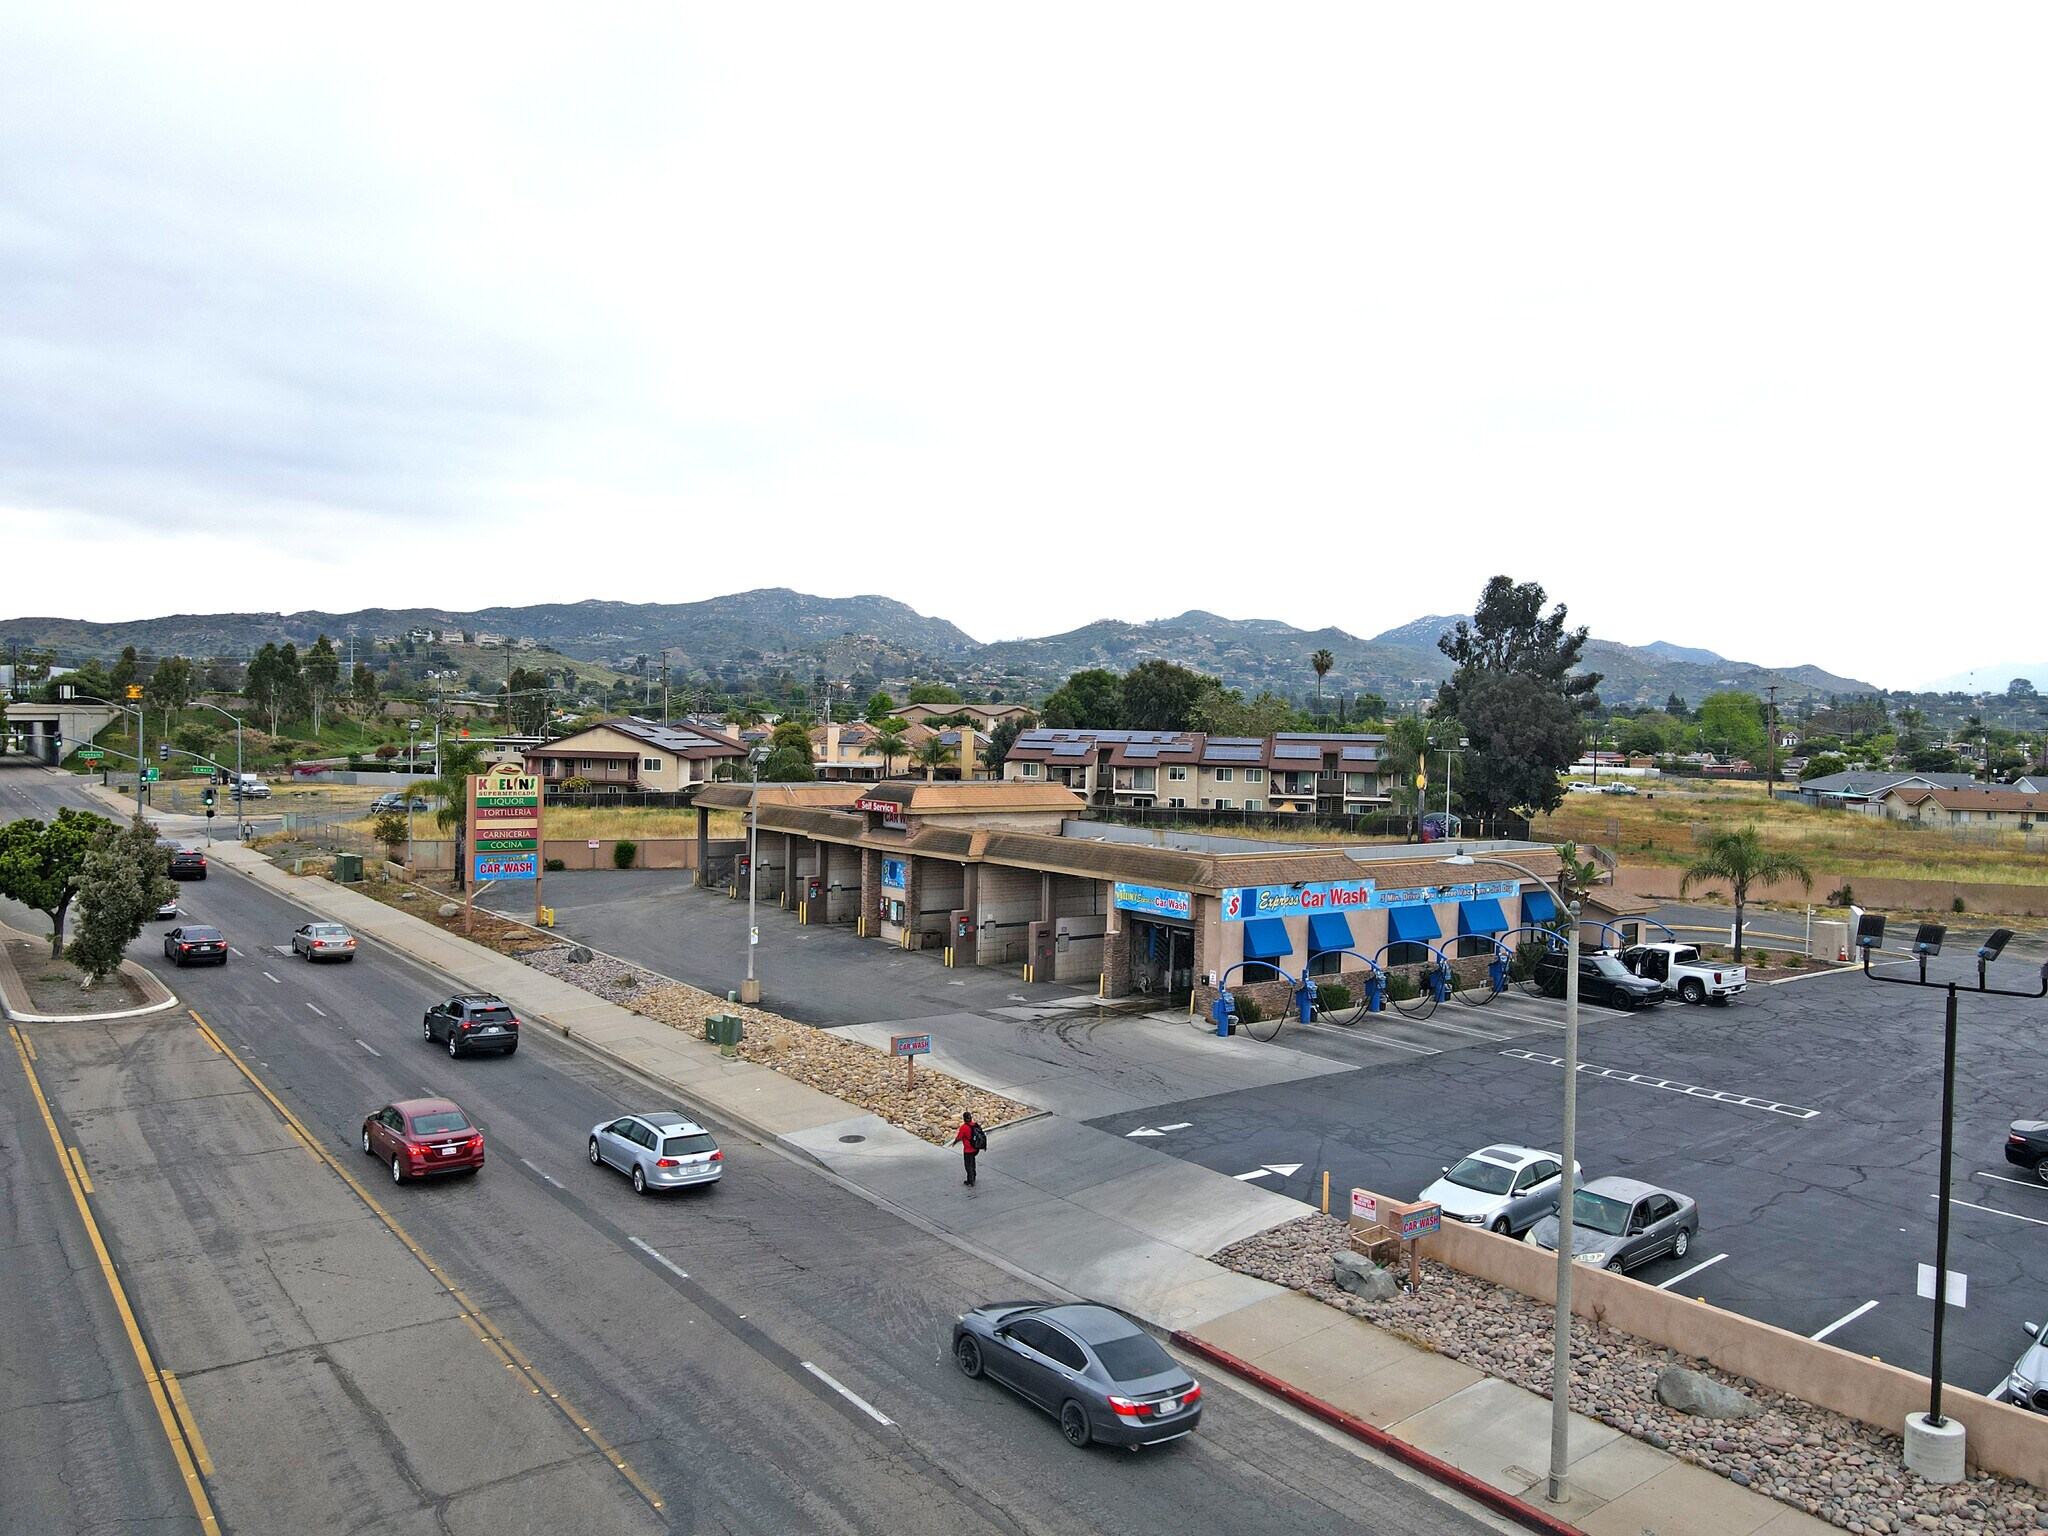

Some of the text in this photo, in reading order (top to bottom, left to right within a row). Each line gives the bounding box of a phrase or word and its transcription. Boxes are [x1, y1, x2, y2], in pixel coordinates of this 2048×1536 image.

[489, 798, 525, 806] LIQUOR
[861, 801, 894, 813] Self Service
[483, 808, 532, 817] TORTILLERIA
[884, 813, 899, 823] CAR
[483, 831, 531, 839] CARNICERIA
[490, 841, 523, 849] COCINA
[480, 862, 532, 874] CAR WASH
[1403, 891, 1421, 900] Drive
[1490, 885, 1501, 894] Jet
[1502, 883, 1514, 894] Dry
[1155, 897, 1167, 908] Car
[1168, 899, 1188, 912] Wash
[1259, 887, 1368, 911] Express Car Wash
[1229, 897, 1240, 916] $
[899, 1043, 911, 1051] CAR
[912, 1041, 929, 1049] WASH
[1403, 1220, 1418, 1233] CAR
[1419, 1215, 1439, 1229] WASH
